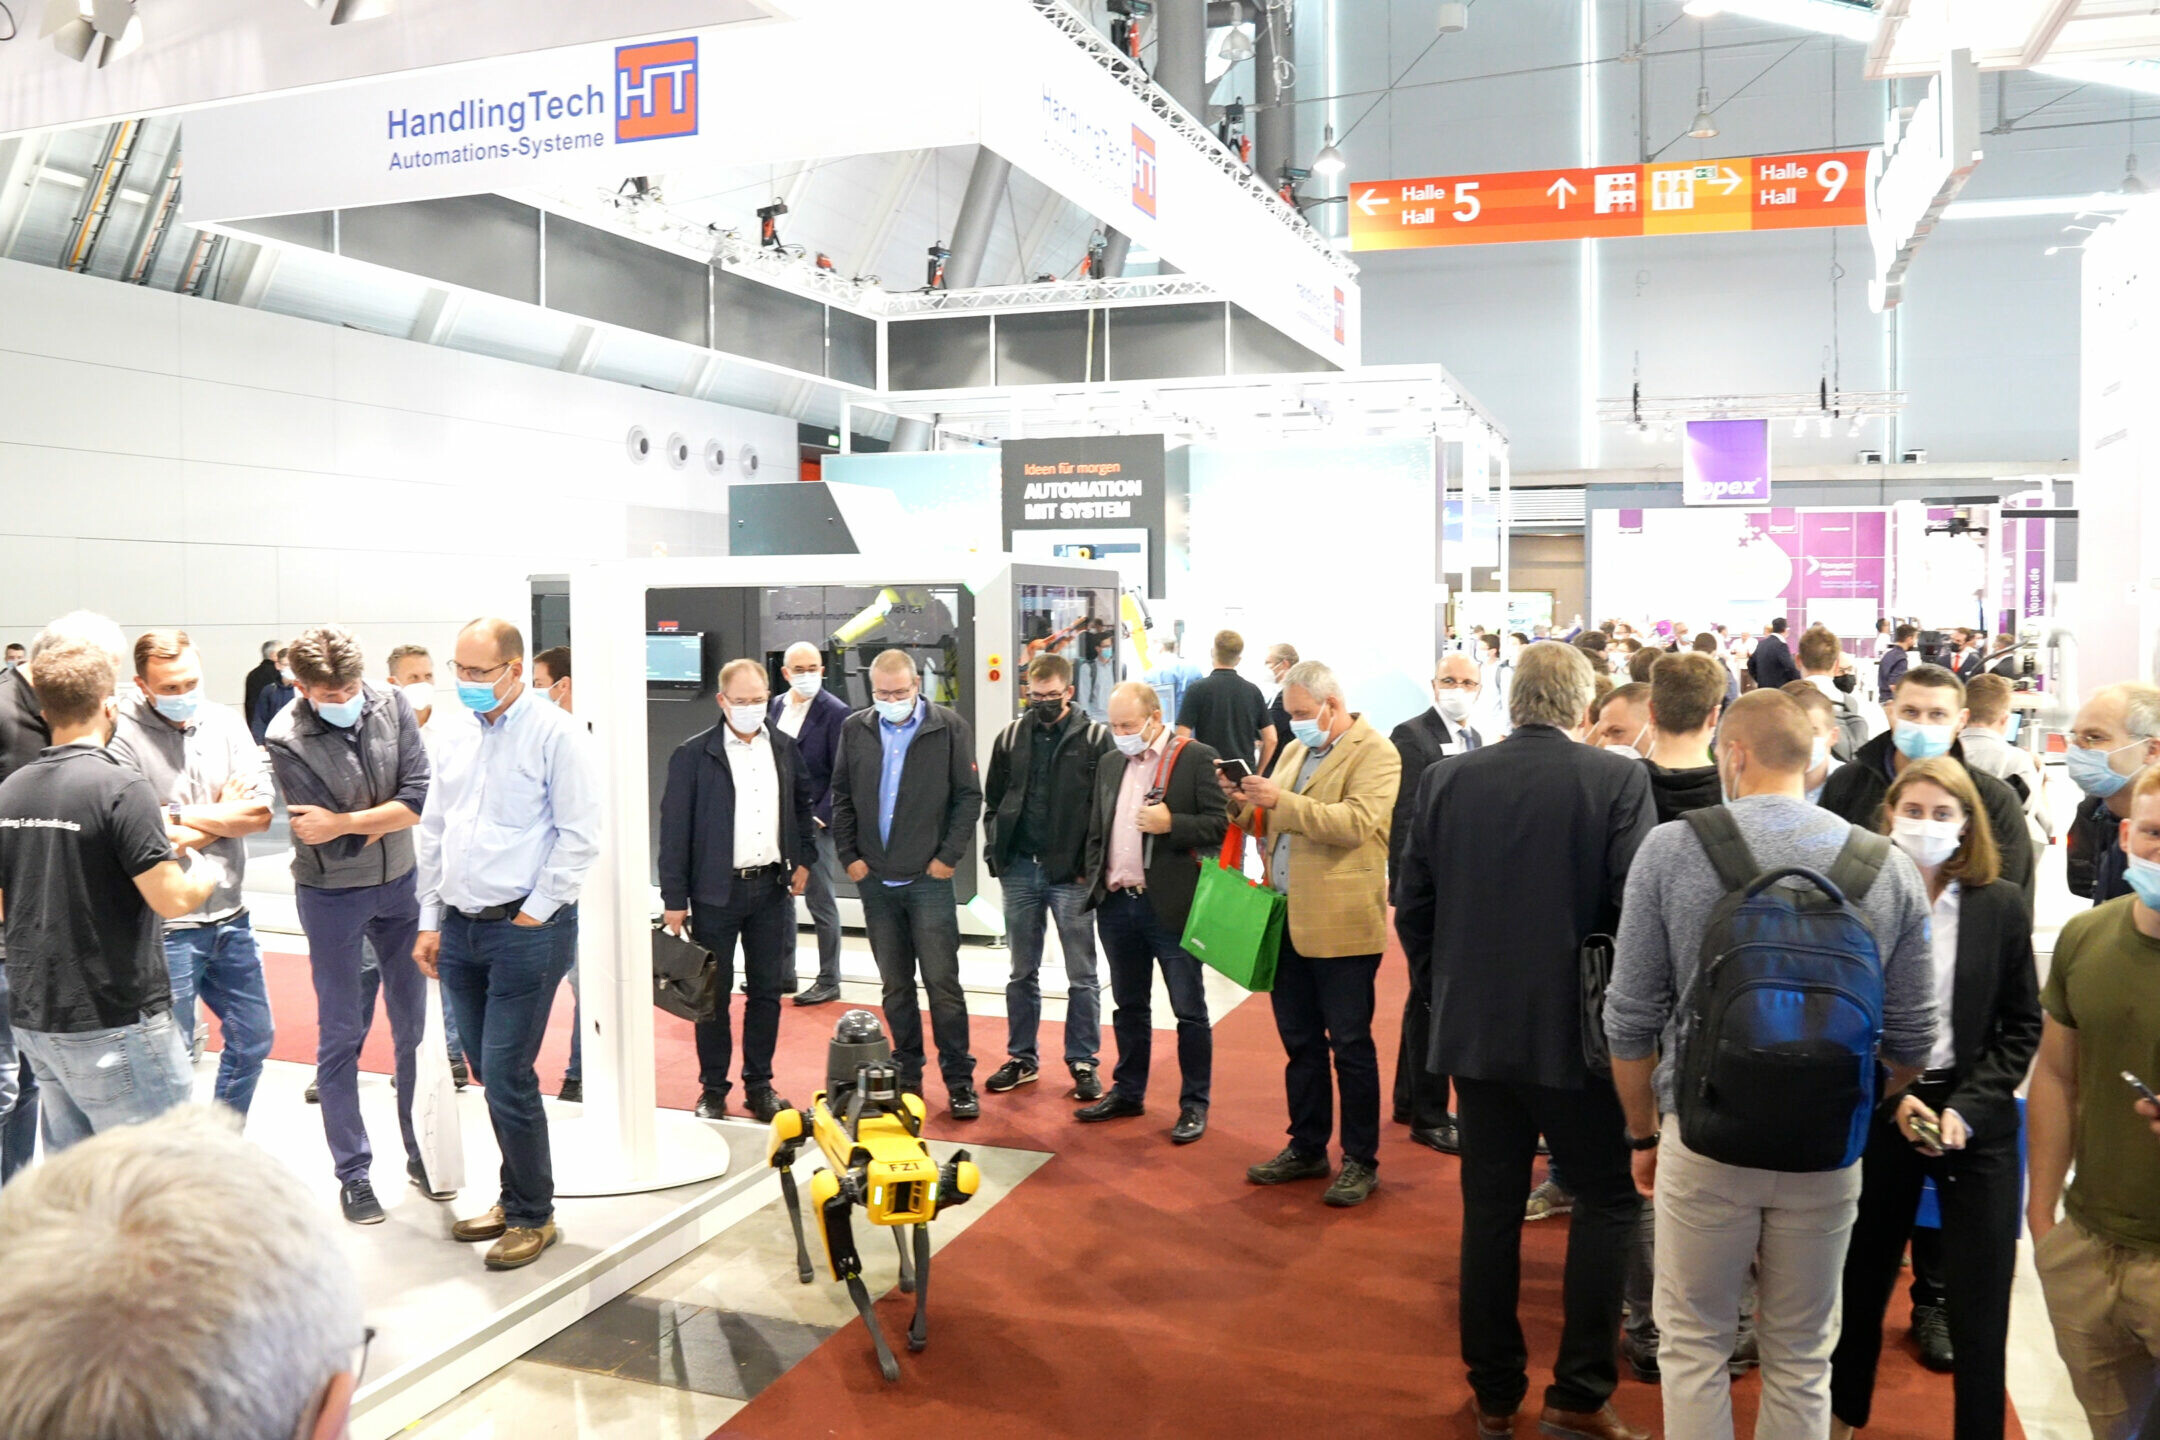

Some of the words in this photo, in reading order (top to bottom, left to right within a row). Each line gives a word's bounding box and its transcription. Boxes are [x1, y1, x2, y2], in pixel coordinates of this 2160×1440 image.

[388, 84, 604, 139] HandlingTech
[388, 132, 605, 171] Automations-Systeme
[1760, 162, 1808, 181] Halle
[1816, 160, 1849, 202] 9
[1401, 184, 1446, 202] Halle
[1452, 181, 1481, 222] 5
[1760, 187, 1797, 205] Hall
[1401, 207, 1435, 225] Hall
[1024, 463, 1056, 476] Ideen
[1058, 462, 1075, 474] für
[1076, 462, 1121, 476] morgen
[1023, 479, 1143, 500] AUTOMATION
[1024, 502, 1058, 520] MIT
[1060, 501, 1131, 519] SYSTEM
[889, 1162, 920, 1173] FZI
